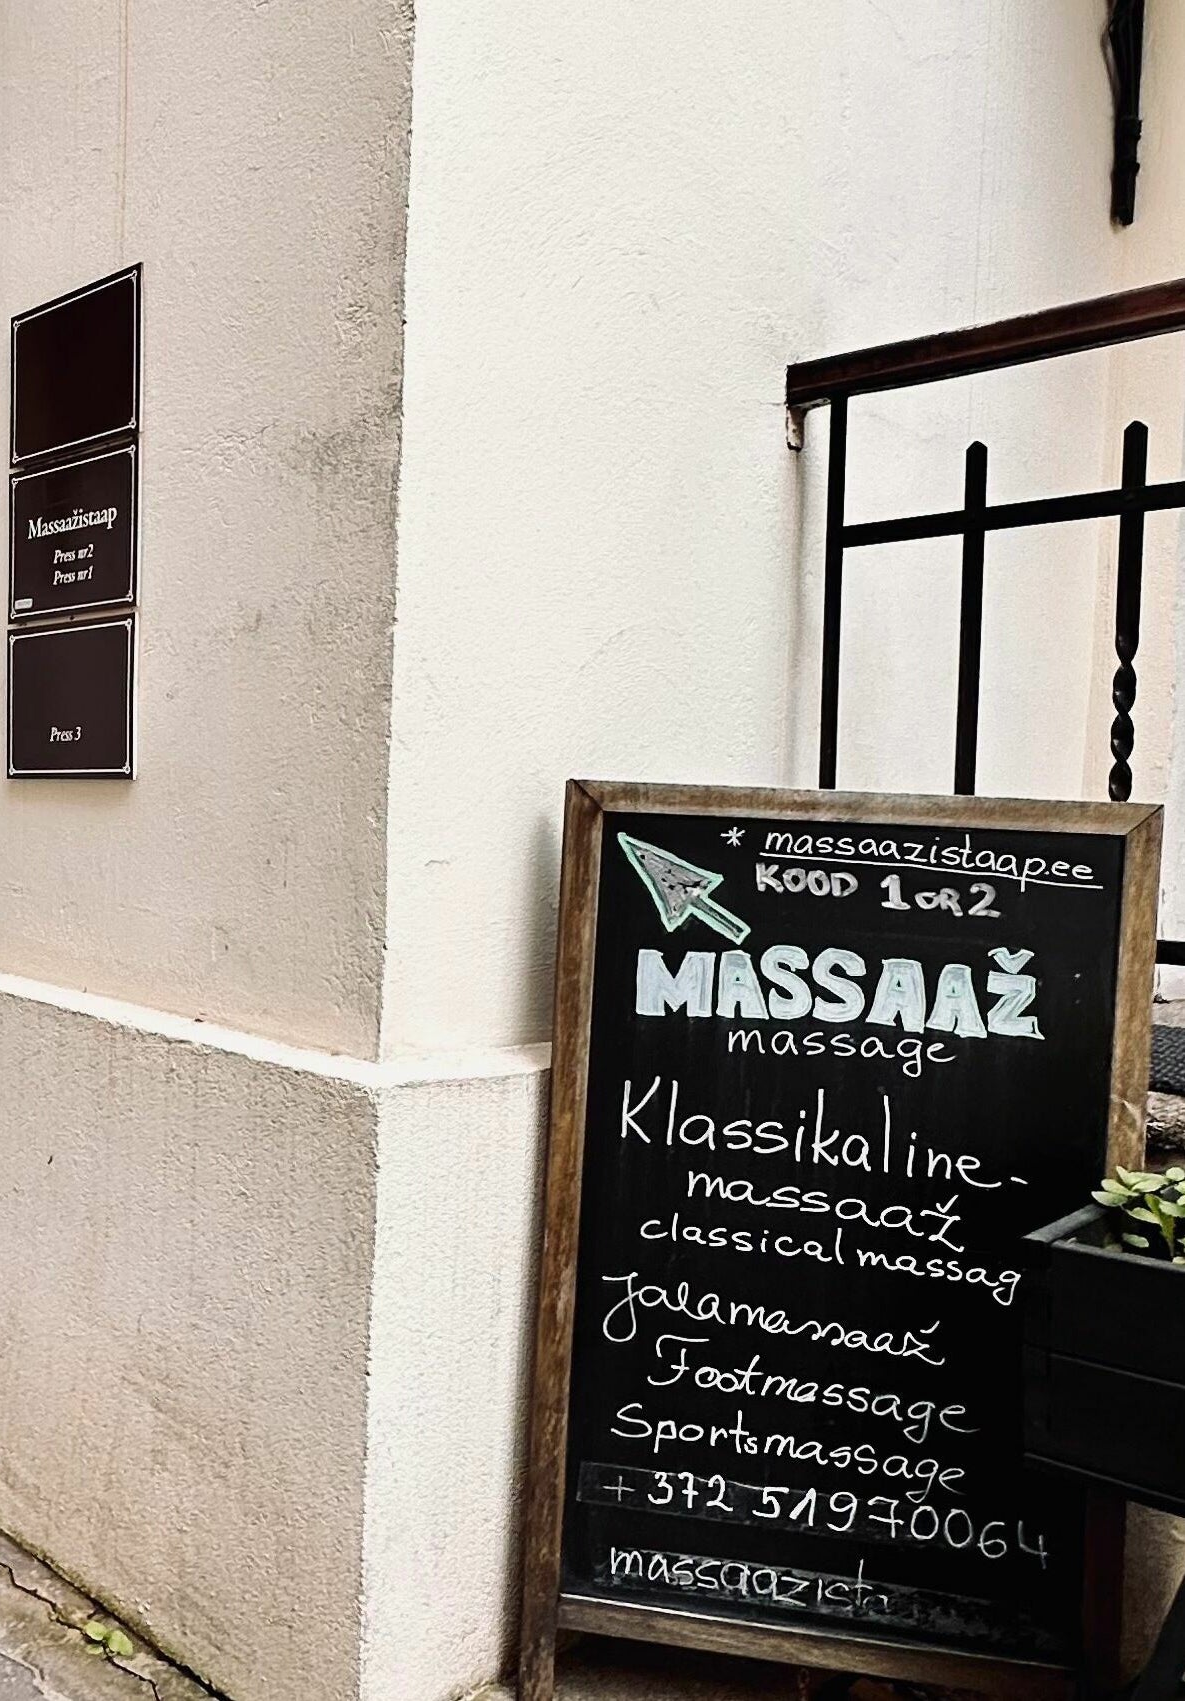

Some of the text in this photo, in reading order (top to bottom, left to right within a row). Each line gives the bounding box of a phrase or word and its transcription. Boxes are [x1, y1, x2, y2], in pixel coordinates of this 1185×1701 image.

[28, 507, 118, 539] Massaažistaap
[53, 549, 75, 564] Press
[53, 570, 75, 585] Press
[50, 726, 82, 742] Press 3
[755, 863, 859, 897] KOOD
[880, 874, 911, 910] 1
[967, 882, 1002, 918] 2
[765, 832, 1095, 892] massaazistaap.ee
[635, 945, 1046, 1040] MASSAAŽ
[728, 1027, 956, 1078] massage
[687, 1170, 965, 1253] massaaž
[640, 1212, 1022, 1306] classical massag
[646, 1334, 980, 1444] Footmassage
[610, 1402, 967, 1501] Sportsmassage
[647, 1470, 734, 1512] 372
[751, 1486, 1049, 1571] 51970064
